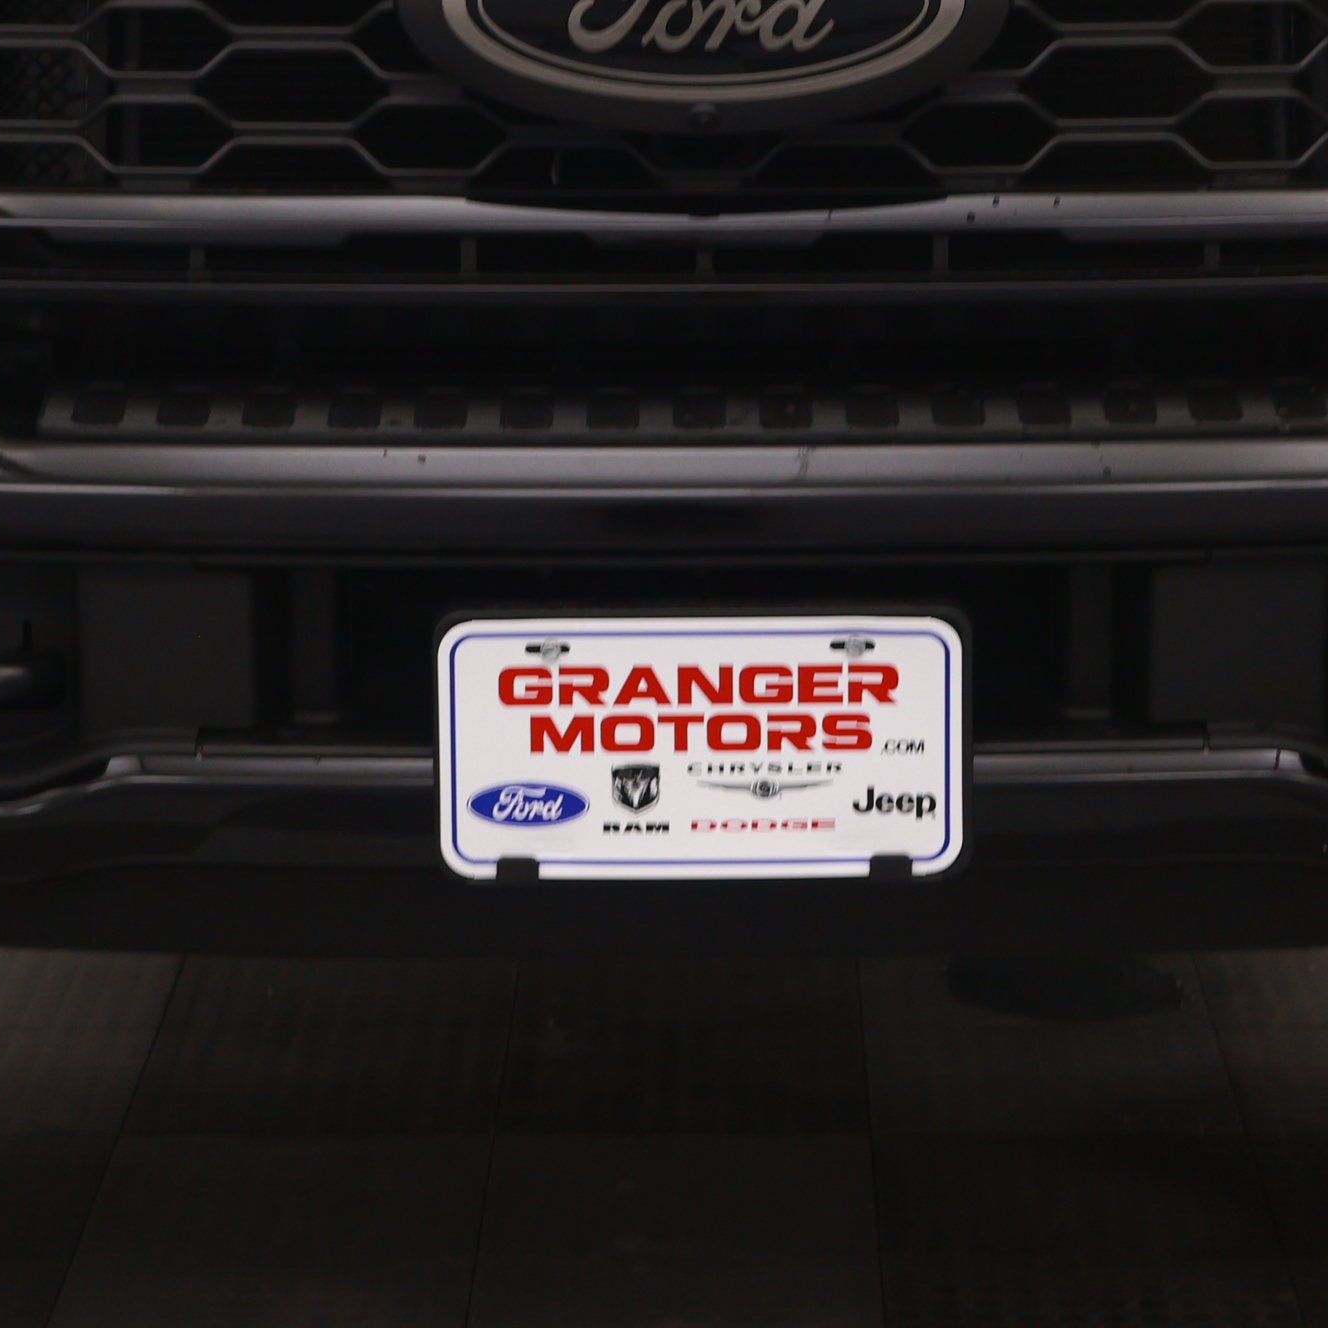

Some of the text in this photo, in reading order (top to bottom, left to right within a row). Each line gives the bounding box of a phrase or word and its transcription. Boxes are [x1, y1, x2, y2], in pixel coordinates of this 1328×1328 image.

[498, 663, 900, 706] GRANGER
[530, 712, 873, 754] MOTORS
[687, 761, 842, 775] CHRYSLER
[492, 785, 564, 821] Ford
[852, 784, 937, 821] Jeep
[603, 822, 670, 834] RAM
[690, 818, 836, 831] DODGE
